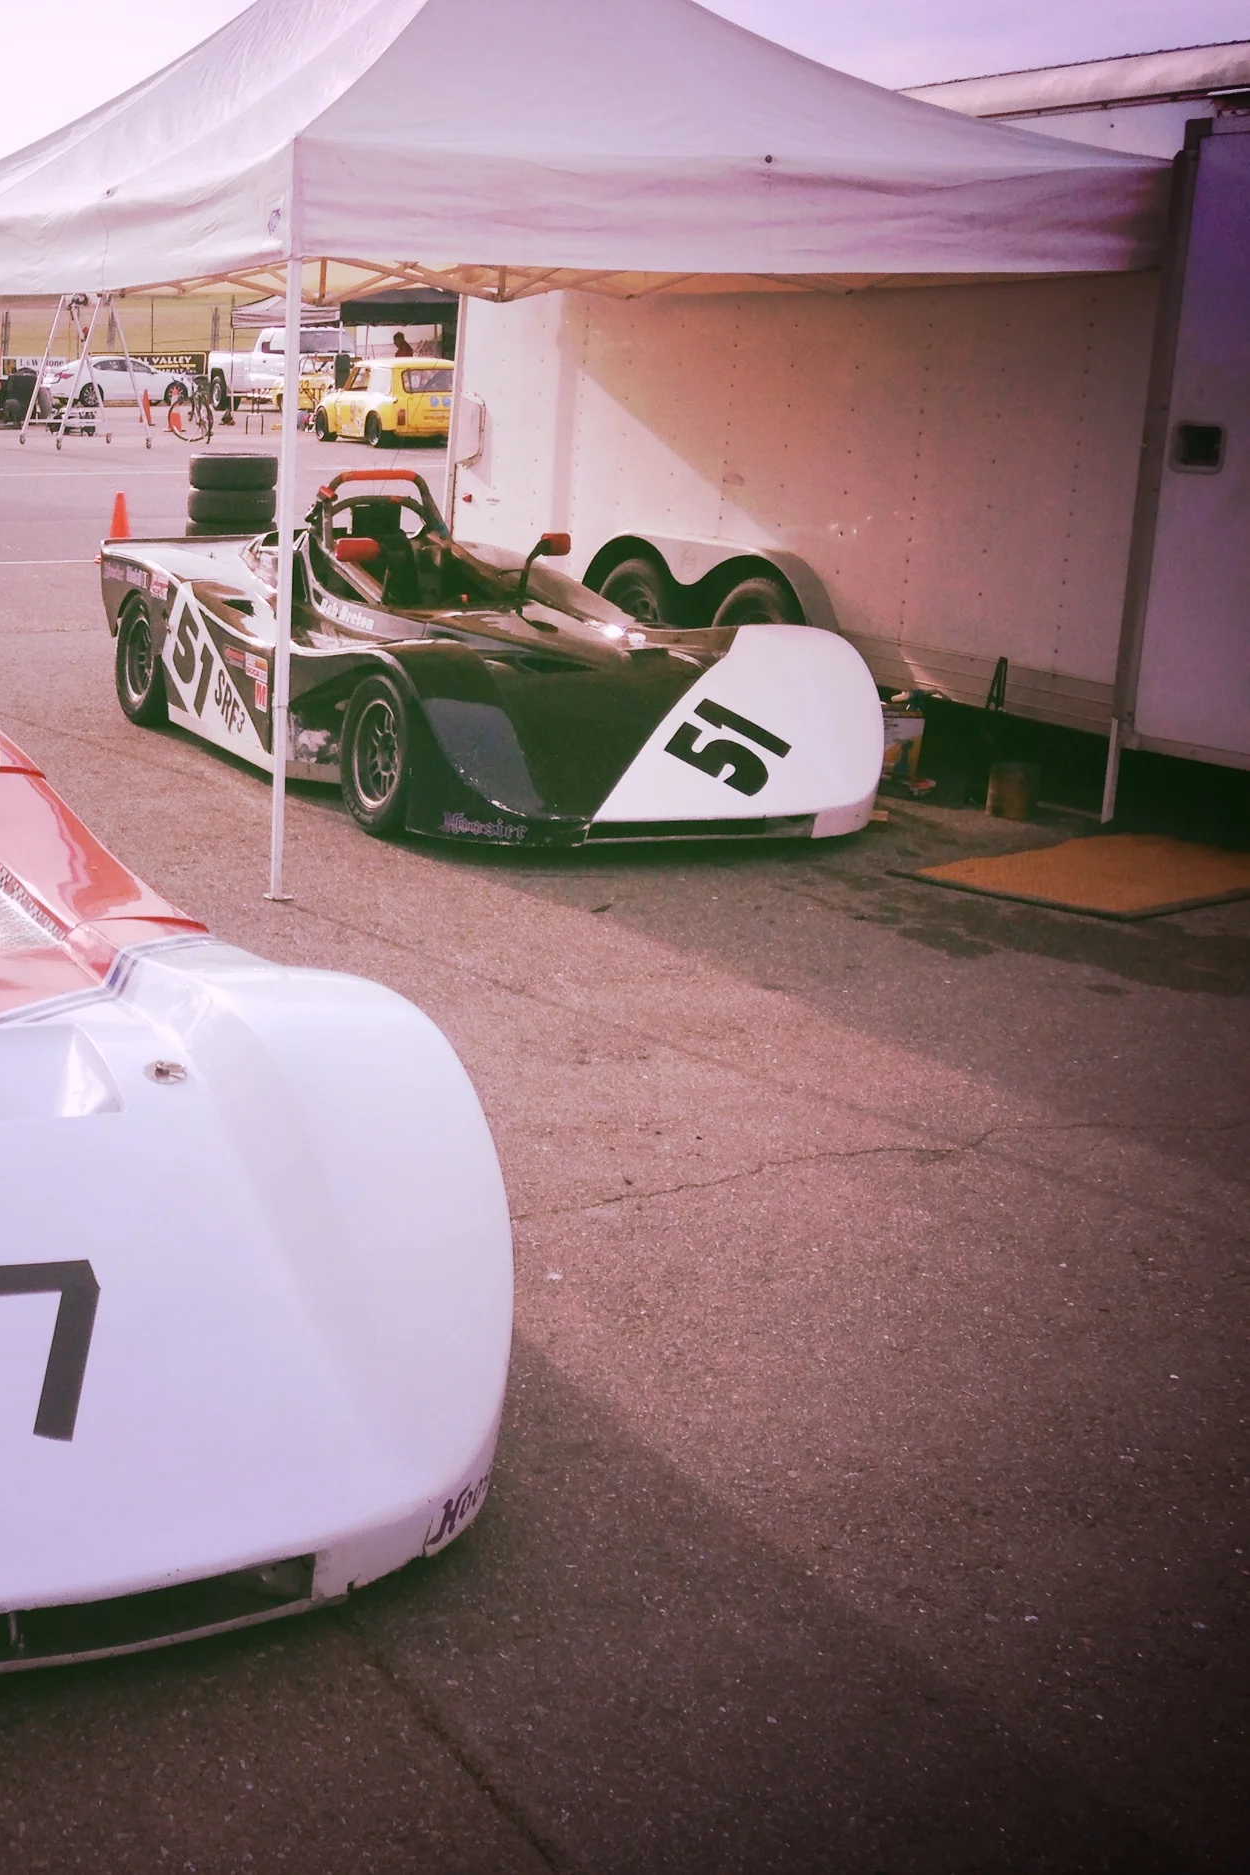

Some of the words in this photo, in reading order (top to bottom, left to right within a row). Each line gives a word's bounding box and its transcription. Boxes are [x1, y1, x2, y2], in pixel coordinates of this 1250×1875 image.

[152, 355, 192, 364] VALLEY
[172, 601, 214, 719] 51
[663, 698, 792, 797] 51
[438, 811, 529, 840] Hoosier
